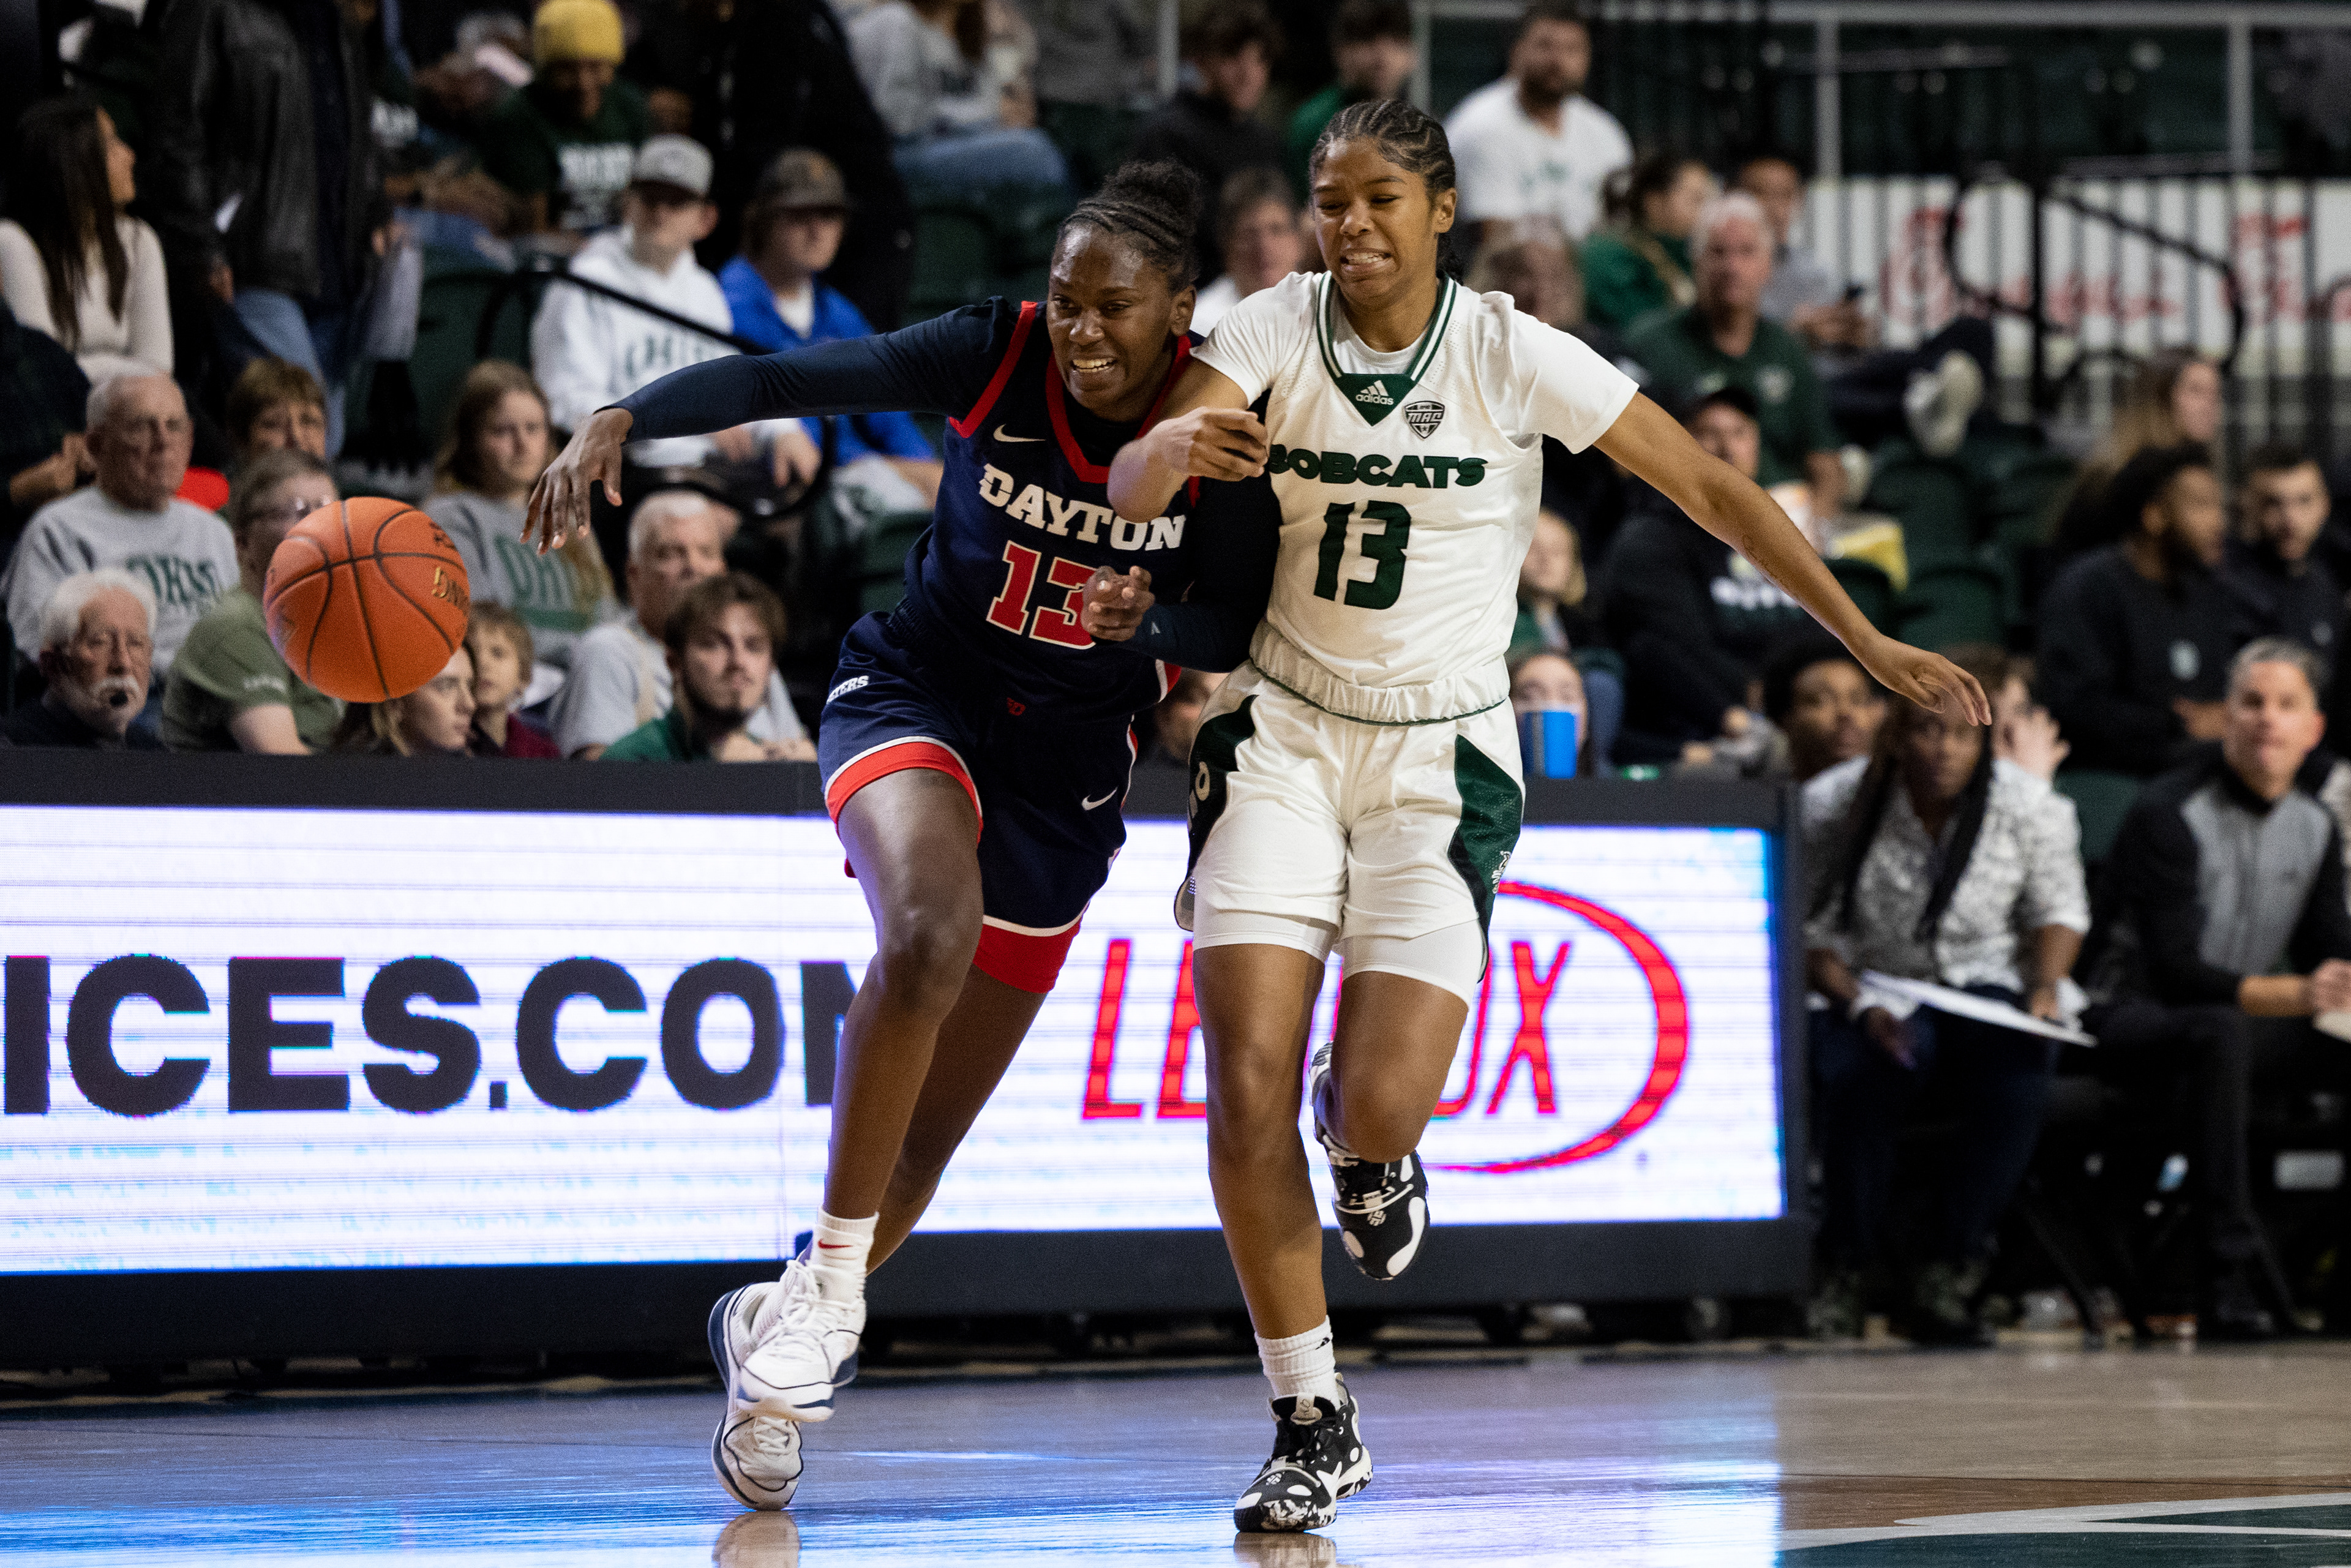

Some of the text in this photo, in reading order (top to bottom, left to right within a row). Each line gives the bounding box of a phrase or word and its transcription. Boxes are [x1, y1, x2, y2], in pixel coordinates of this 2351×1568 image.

[1355, 393, 1394, 405] adidas
[1408, 412, 1443, 422] MAC
[1269, 443, 1488, 489] BOBCATS
[979, 463, 1187, 551] DAYTON
[1313, 500, 1411, 610] 13
[1082, 939, 1571, 1120] LEX
